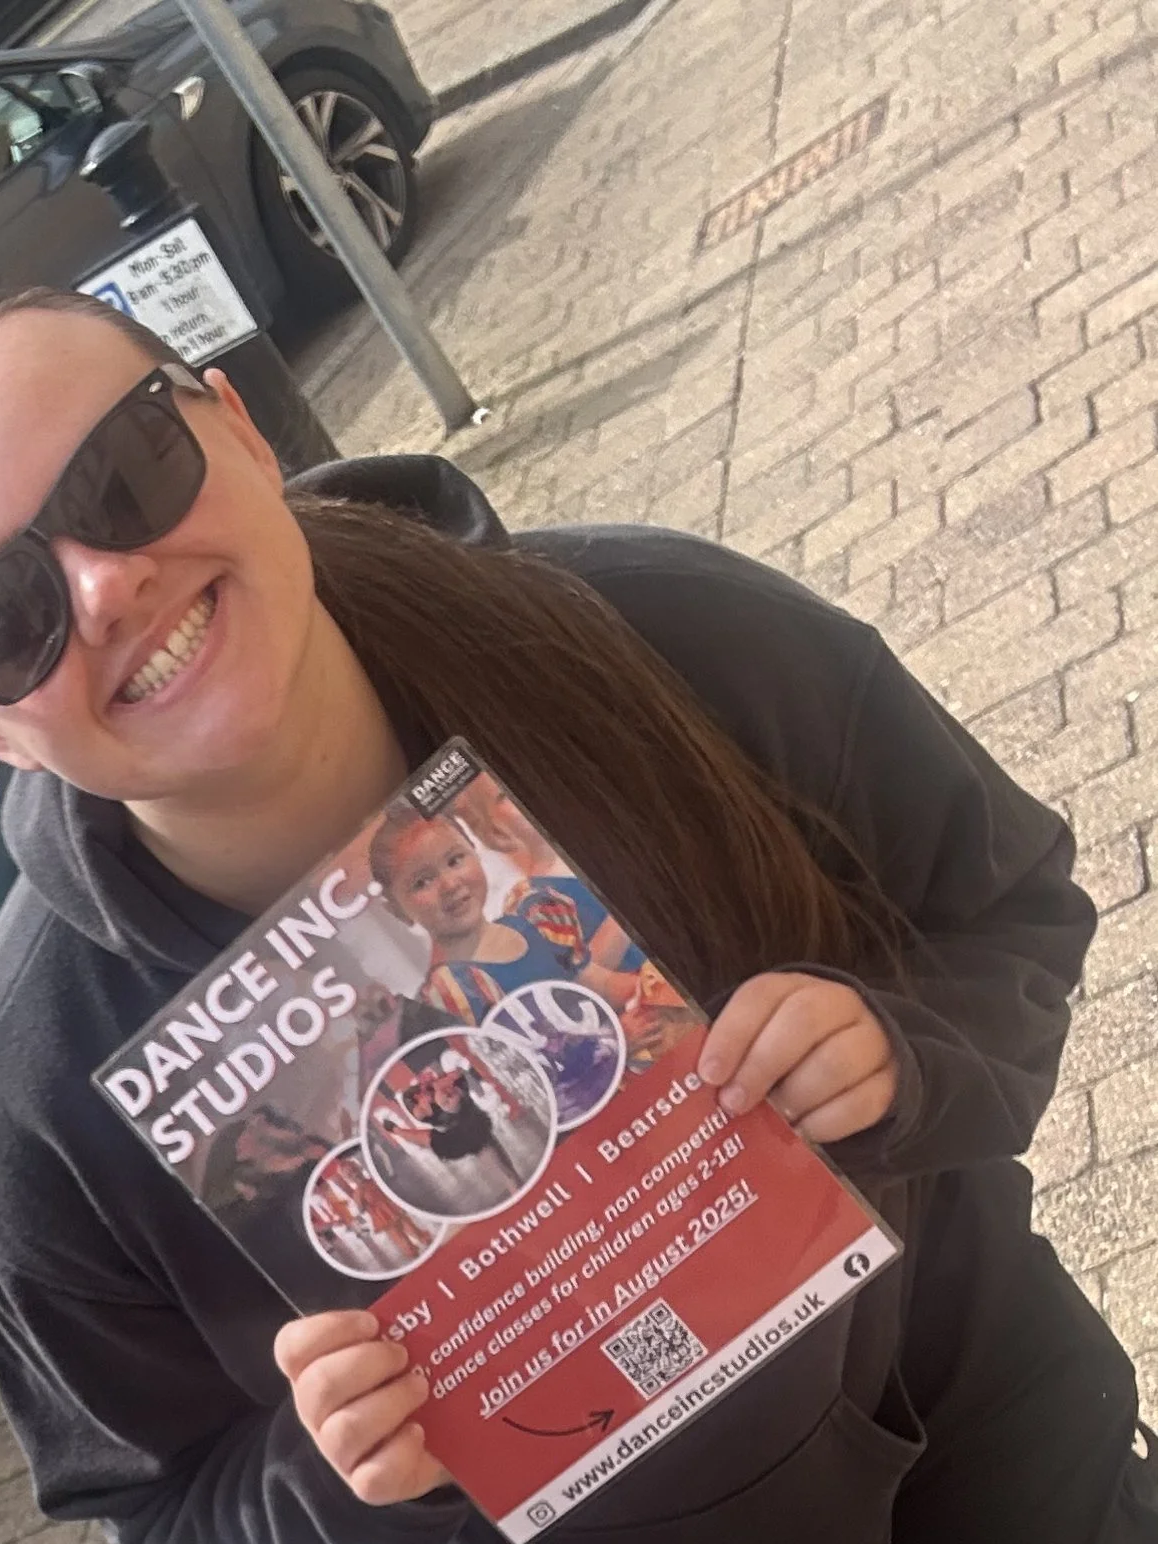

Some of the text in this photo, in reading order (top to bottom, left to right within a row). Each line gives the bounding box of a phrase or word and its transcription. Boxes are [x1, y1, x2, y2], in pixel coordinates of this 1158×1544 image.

[104, 868, 384, 1119] DANCE INC.
[151, 966, 357, 1164] STUDIOS
[383, 1298, 432, 1342] sby
[458, 1181, 572, 1281] Bothwell
[597, 1070, 703, 1164] Bearsde
[429, 1280, 526, 1366] confidence
[524, 1218, 605, 1287] building,
[604, 1185, 641, 1223] non
[641, 1108, 730, 1190] competiti
[432, 1133, 746, 1399] dance classes for children ages 2-18!
[478, 1178, 759, 1417] Join us for in August 2025!
[562, 1291, 826, 1502] www.danceincstudios.uk
